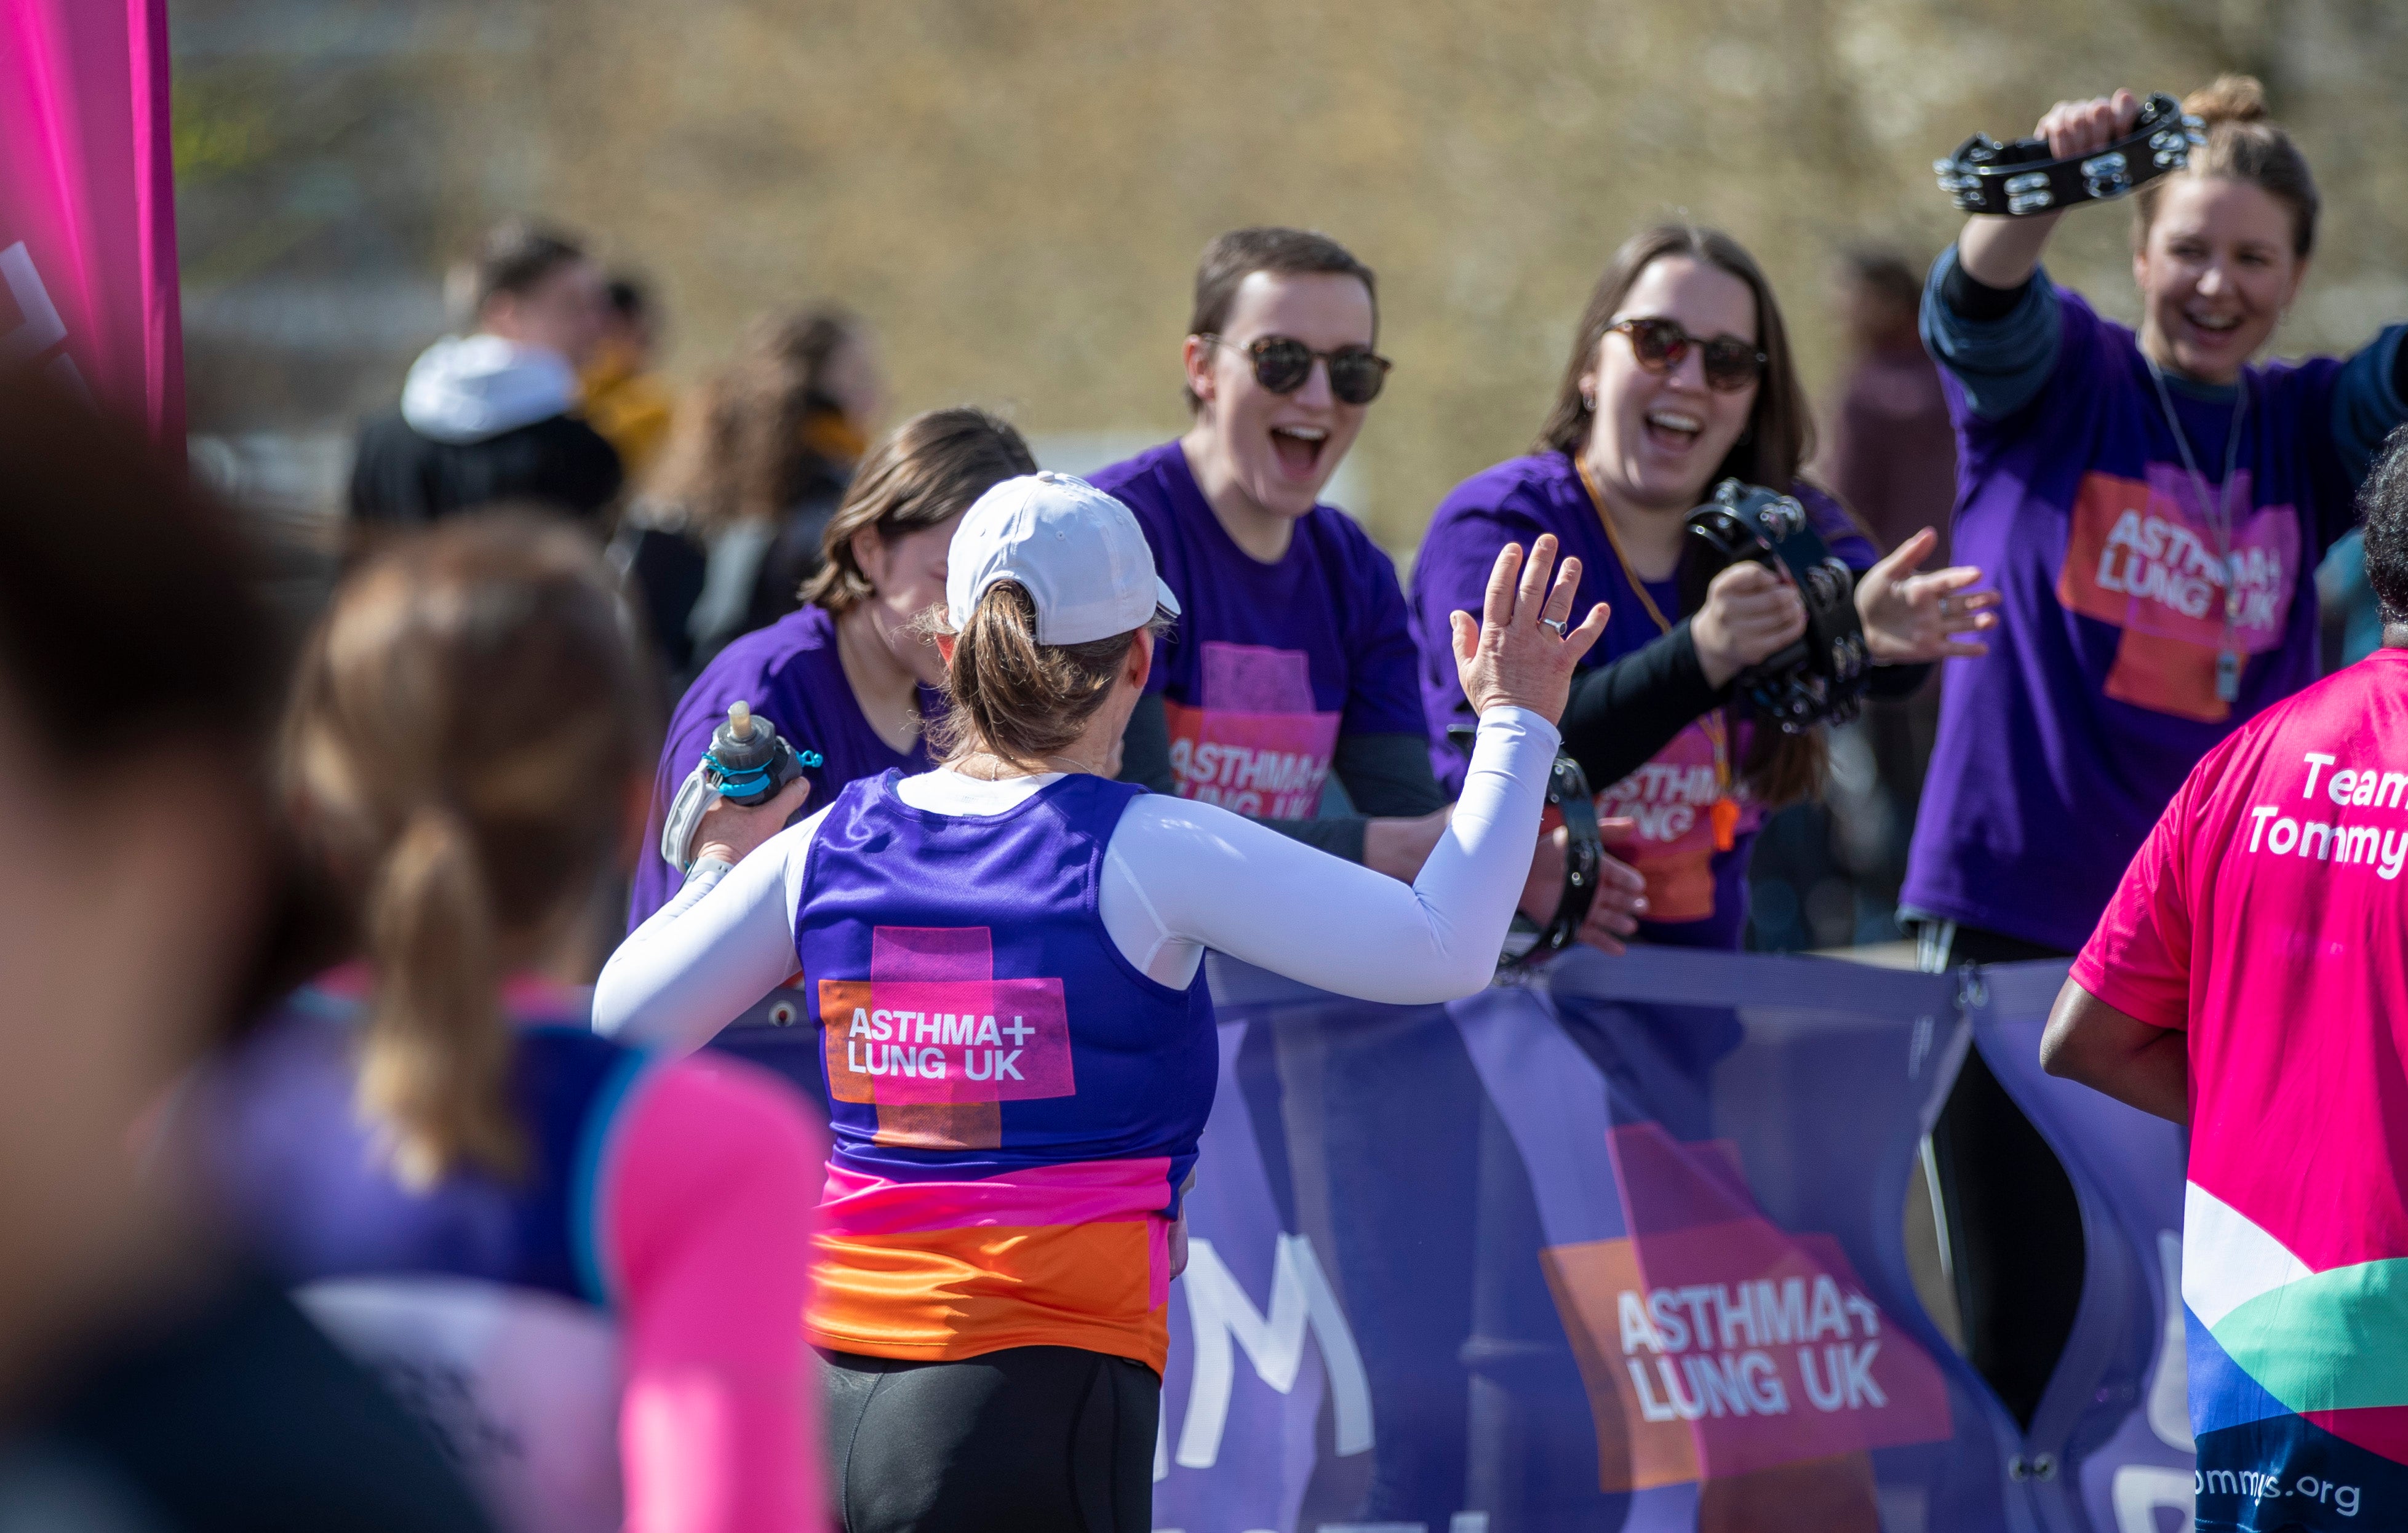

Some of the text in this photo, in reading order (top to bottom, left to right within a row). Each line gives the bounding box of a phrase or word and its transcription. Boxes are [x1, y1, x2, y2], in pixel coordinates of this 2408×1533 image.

[2094, 547, 2213, 619] LUNG
[2249, 806, 2408, 880] Tommy
[848, 1008, 1035, 1046] ASTHMA+
[848, 1041, 1025, 1081] LUNG UK
[1627, 1339, 1889, 1422] LUNG UK
